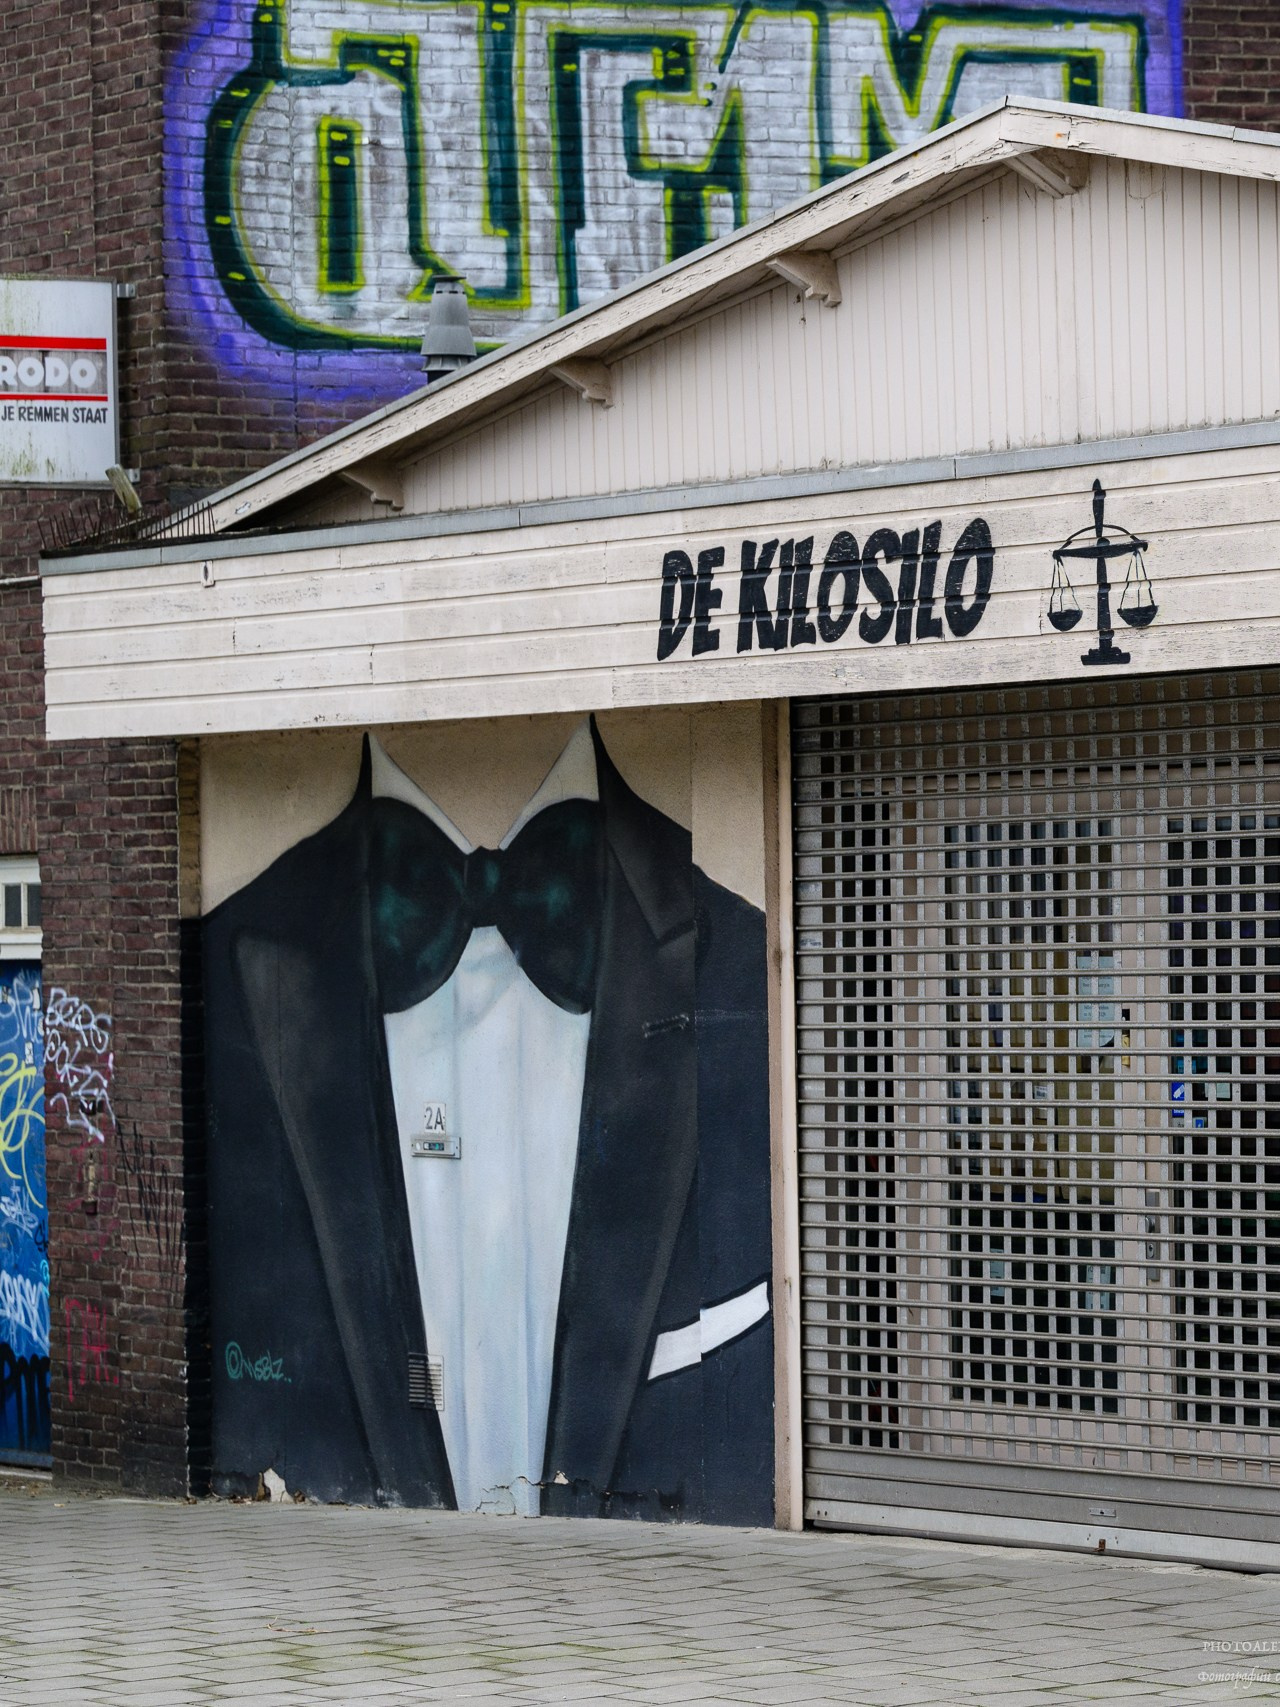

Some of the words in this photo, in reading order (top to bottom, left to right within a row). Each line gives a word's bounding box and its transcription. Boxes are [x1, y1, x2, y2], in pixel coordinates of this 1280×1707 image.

[1, 405, 15, 421] JE
[18, 406, 69, 423] REMMEN
[72, 407, 108, 424] STAAT
[657, 545, 725, 661] DE
[736, 517, 994, 653] KILOSILO
[425, 1106, 444, 1131] 2A
